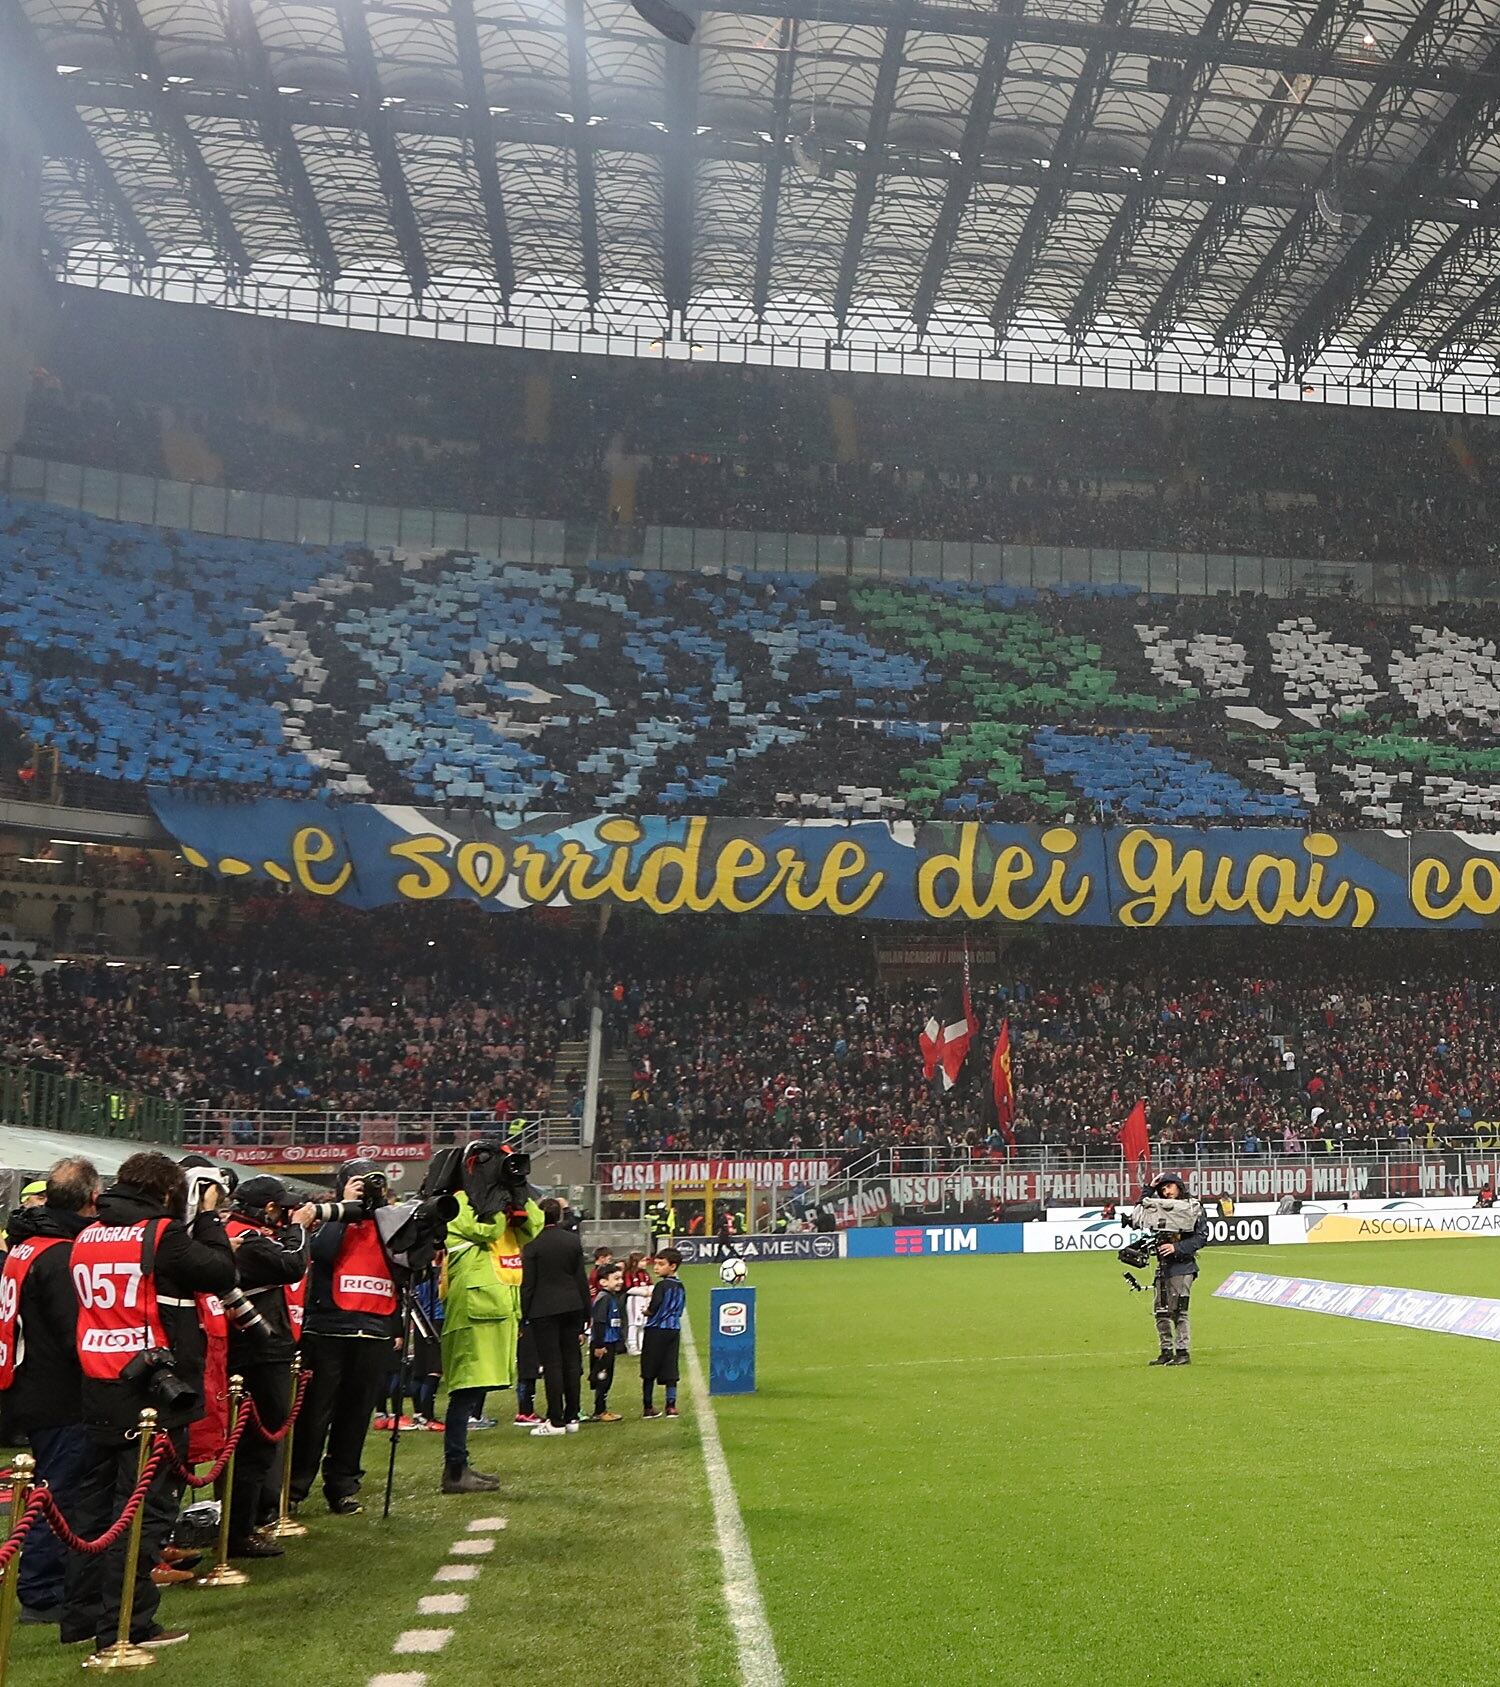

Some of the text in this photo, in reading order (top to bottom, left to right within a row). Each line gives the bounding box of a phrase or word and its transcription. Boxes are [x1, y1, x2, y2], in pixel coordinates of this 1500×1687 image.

[390, 815, 883, 915] sorridere
[918, 822, 1091, 920] dei
[1117, 829, 1376, 927] guai,
[236, 1147, 424, 1162] ALGIDA ALGIDA ALGIDA
[612, 1164, 655, 1190] CASA
[660, 1162, 710, 1189] MILAN
[728, 1161, 785, 1187] JUNIOR
[789, 1161, 829, 1186] CLUB
[1036, 1173, 1119, 1199] ITALIANA
[1189, 1170, 1235, 1196] CLUB
[1242, 1169, 1306, 1194] MONDO
[1313, 1167, 1368, 1192] MILAN
[1419, 1164, 1490, 1190] MIAN
[805, 1187, 888, 1225] BLZANO
[1358, 1216, 1435, 1235] ASCOLTA
[699, 1241, 759, 1258] NIVEA
[763, 1239, 810, 1255] MEN
[925, 1227, 977, 1252] TIM
[1054, 1233, 1124, 1250] BANCO
[73, 1262, 142, 1309] 057
[343, 1278, 394, 1294] RICOH
